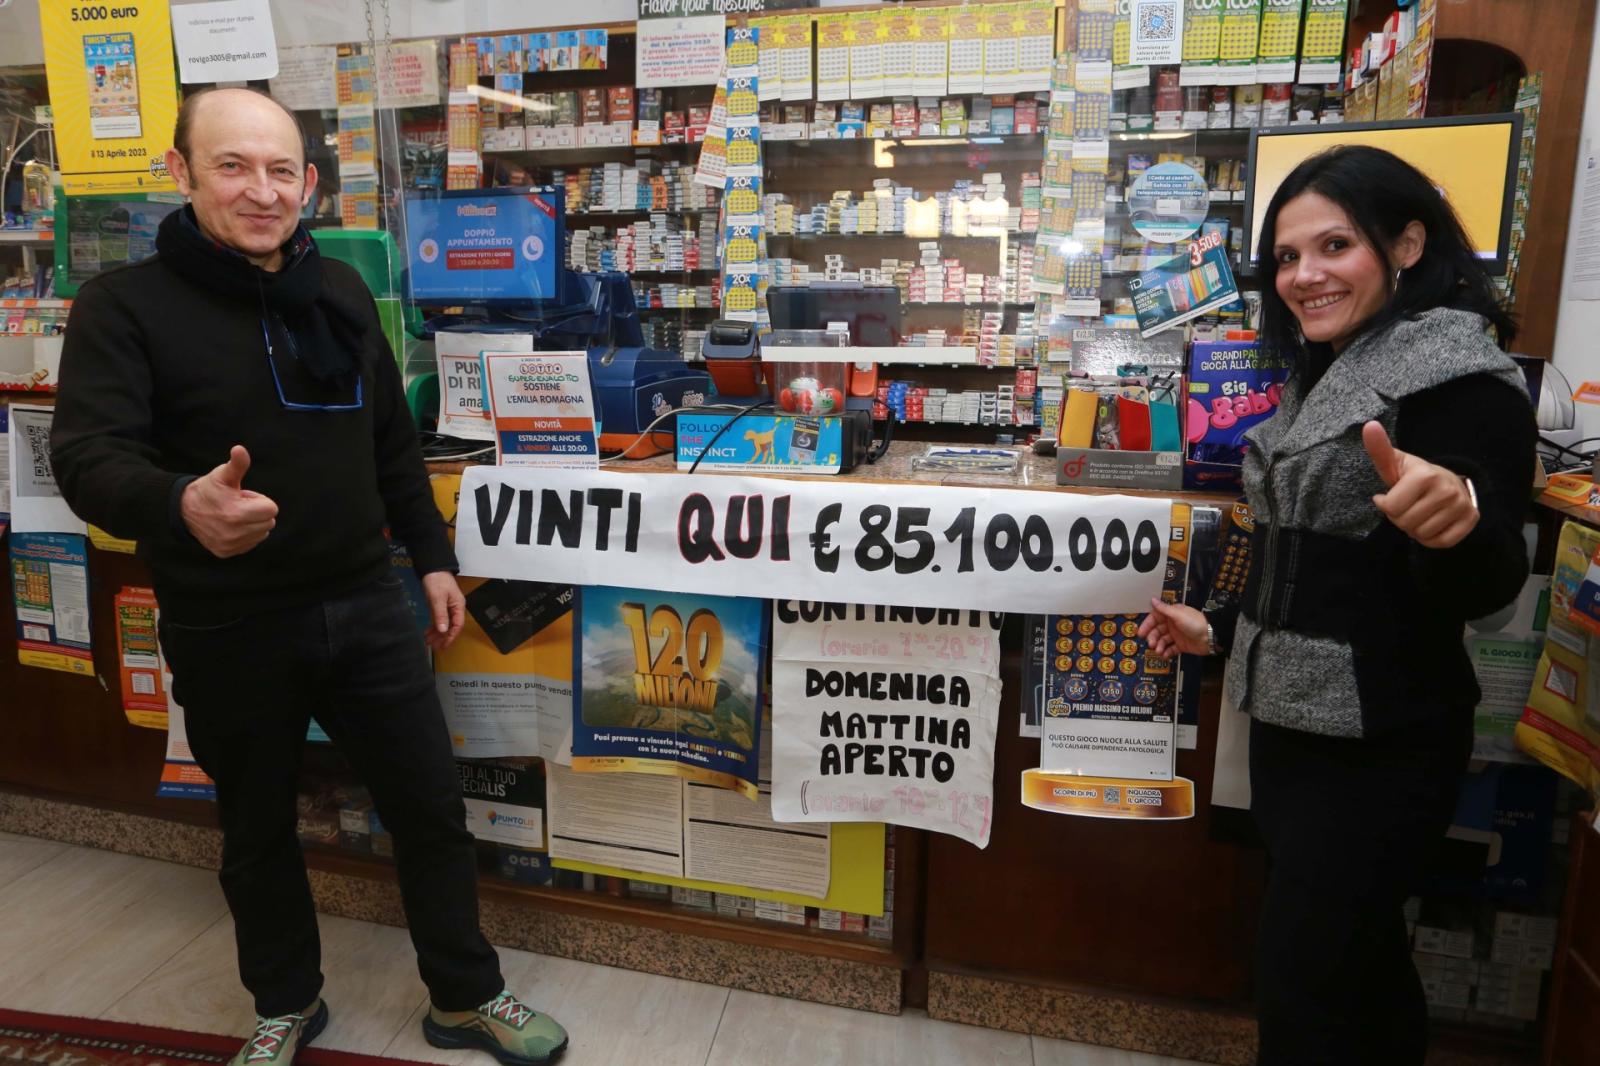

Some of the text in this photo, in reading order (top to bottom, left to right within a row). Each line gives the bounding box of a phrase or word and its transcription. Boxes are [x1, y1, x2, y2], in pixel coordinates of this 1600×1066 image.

[71, 6, 138, 21] 5.000 euro
[681, 0, 710, 16] your
[106, 149, 127, 158] Aprile
[128, 148, 147, 156] 2023
[464, 229, 495, 238] DOPPIO
[447, 238, 513, 247] APPUNTAMENTO
[1211, 351, 1242, 361] GRANDI
[455, 361, 481, 375] PUN
[520, 363, 563, 375] LOTTO
[1201, 360, 1251, 371] GIOCA ALLA
[448, 376, 481, 390] DI RI
[524, 382, 561, 391] SOSTIENE
[1221, 381, 1248, 395] Big
[459, 397, 483, 408] ama
[507, 395, 585, 404] L'EMILIA ROMAGNA
[534, 418, 562, 429] NOVITÀ
[681, 435, 704, 445] THE
[474, 482, 1161, 574] VINTI QUI € 85.100.000
[621, 601, 724, 681] 120
[1491, 648, 1521, 657] GIOCO
[449, 679, 573, 697] Chiedi in questo punto vendit
[635, 672, 717, 714] MILIONI
[805, 668, 970, 708] DOMENICA
[1072, 704, 1094, 712] PREMIO
[1094, 704, 1121, 714] MASSIMO
[1130, 706, 1152, 714] MILIONI
[820, 711, 970, 749] MATTINA
[594, 733, 610, 741] Puoi
[611, 735, 639, 744] provare
[647, 737, 673, 746] vincerlo
[675, 739, 689, 749] ogni
[1048, 734, 1076, 742] QUESTO
[1076, 735, 1099, 743] GIOCO
[1143, 739, 1169, 747] SALUTE
[638, 745, 650, 753] con
[659, 748, 680, 756] nuova
[681, 751, 710, 763] schedina.
[1064, 742, 1091, 750] CAUSARE
[1091, 744, 1128, 752] DIPENDENZA
[1128, 745, 1165, 754] PATOLOGICA
[820, 742, 955, 783] APERTO
[476, 768, 491, 781] AL
[495, 769, 516, 786] TUO
[1054, 788, 1077, 796] SCOPRI
[1084, 788, 1097, 797] PIÙ
[1127, 789, 1161, 797] INQUADRA
[1127, 797, 1161, 805] IL QRCODE
[508, 854, 541, 868] OCB
